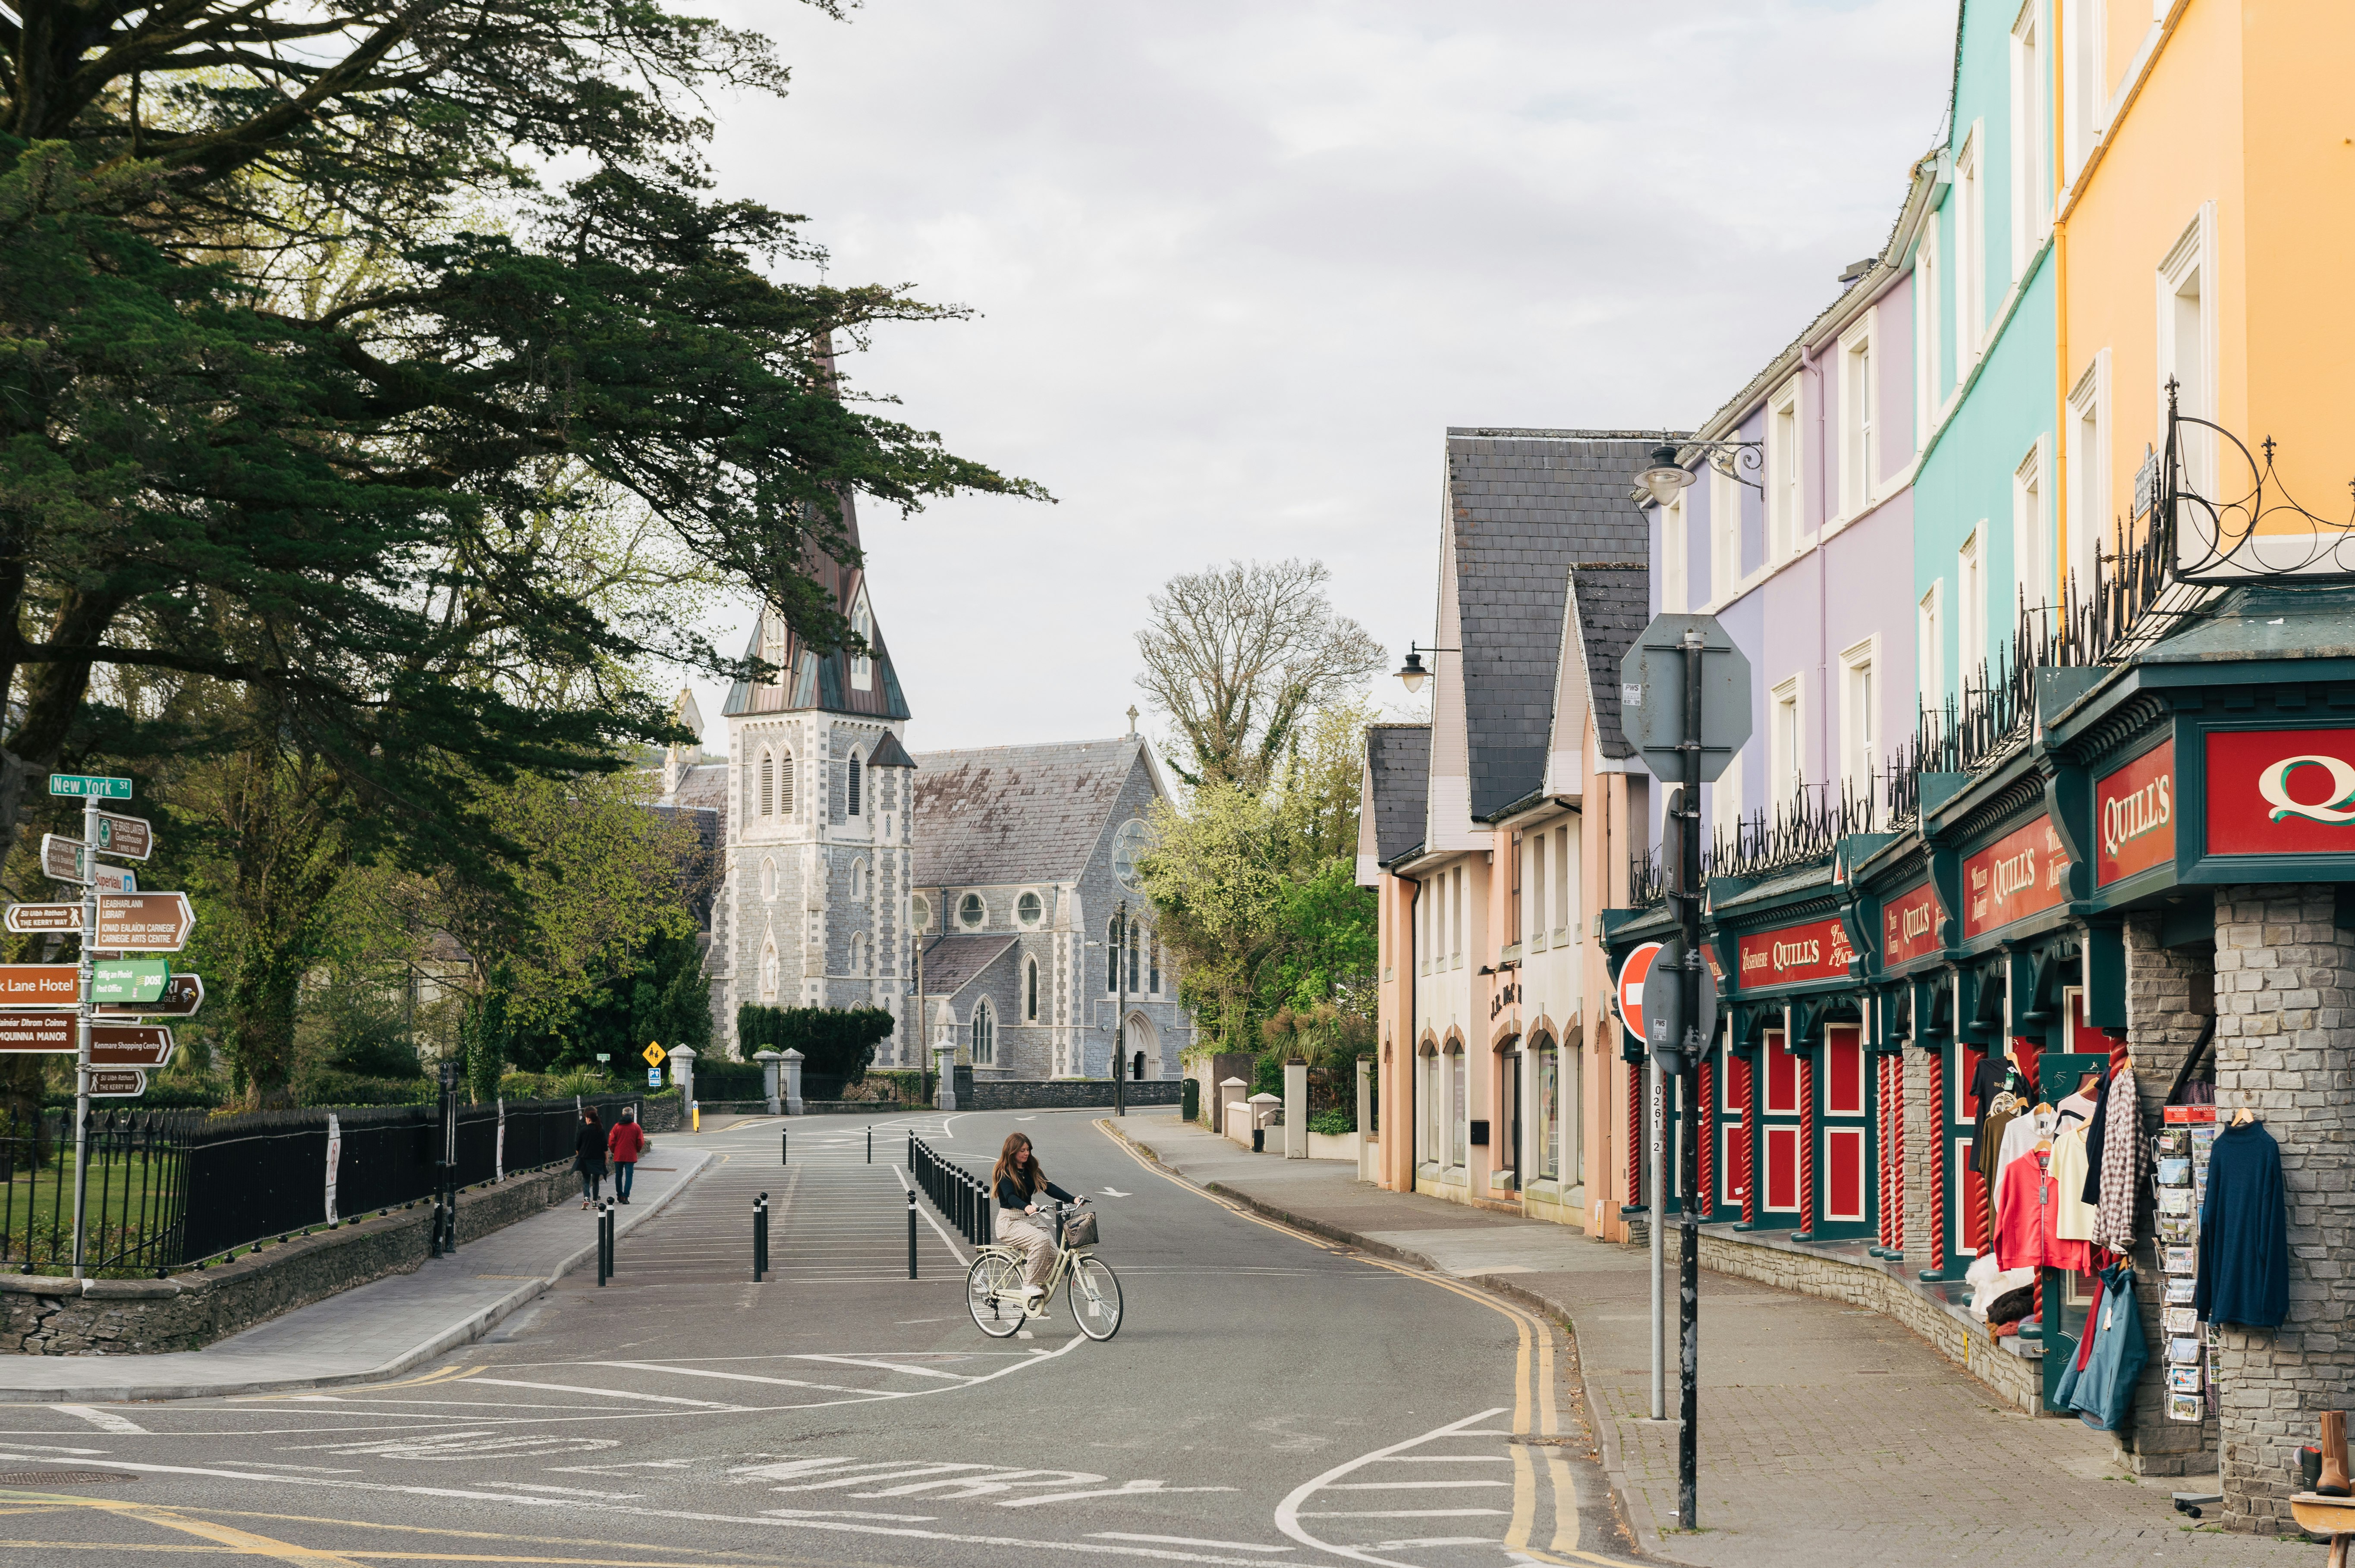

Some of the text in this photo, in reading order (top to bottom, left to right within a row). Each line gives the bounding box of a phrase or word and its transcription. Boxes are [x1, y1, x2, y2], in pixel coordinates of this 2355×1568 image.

[53, 777, 128, 795] New York St
[2104, 774, 2169, 855] QUILL'S
[115, 832, 142, 845] Guesthouse
[96, 872, 121, 890] SuperValu
[1993, 848, 2035, 905] QUILL'S
[103, 900, 143, 908] LEABHARLANN
[102, 910, 126, 919] LIBRARY
[101, 922, 176, 933] IONAD EALAÍON CARNEGIE
[1903, 902, 1930, 944] QUILL'S
[101, 934, 171, 943] CARNEGIE ARTS CENTRE
[1742, 947, 1768, 974] CASHMERE
[1773, 939, 1819, 971] QUILL'S
[97, 970, 110, 981] Oifig
[8, 979, 36, 992] Lane
[39, 979, 73, 991] Hotel
[108, 984, 123, 992] Office
[0, 1018, 67, 1027] ainéar Dhrom Coinne
[37, 1032, 67, 1041] MANOR
[118, 1042, 142, 1051] Shopping
[271, 1431, 622, 1460] NO
[544, 1454, 1245, 1507] ENTRY
